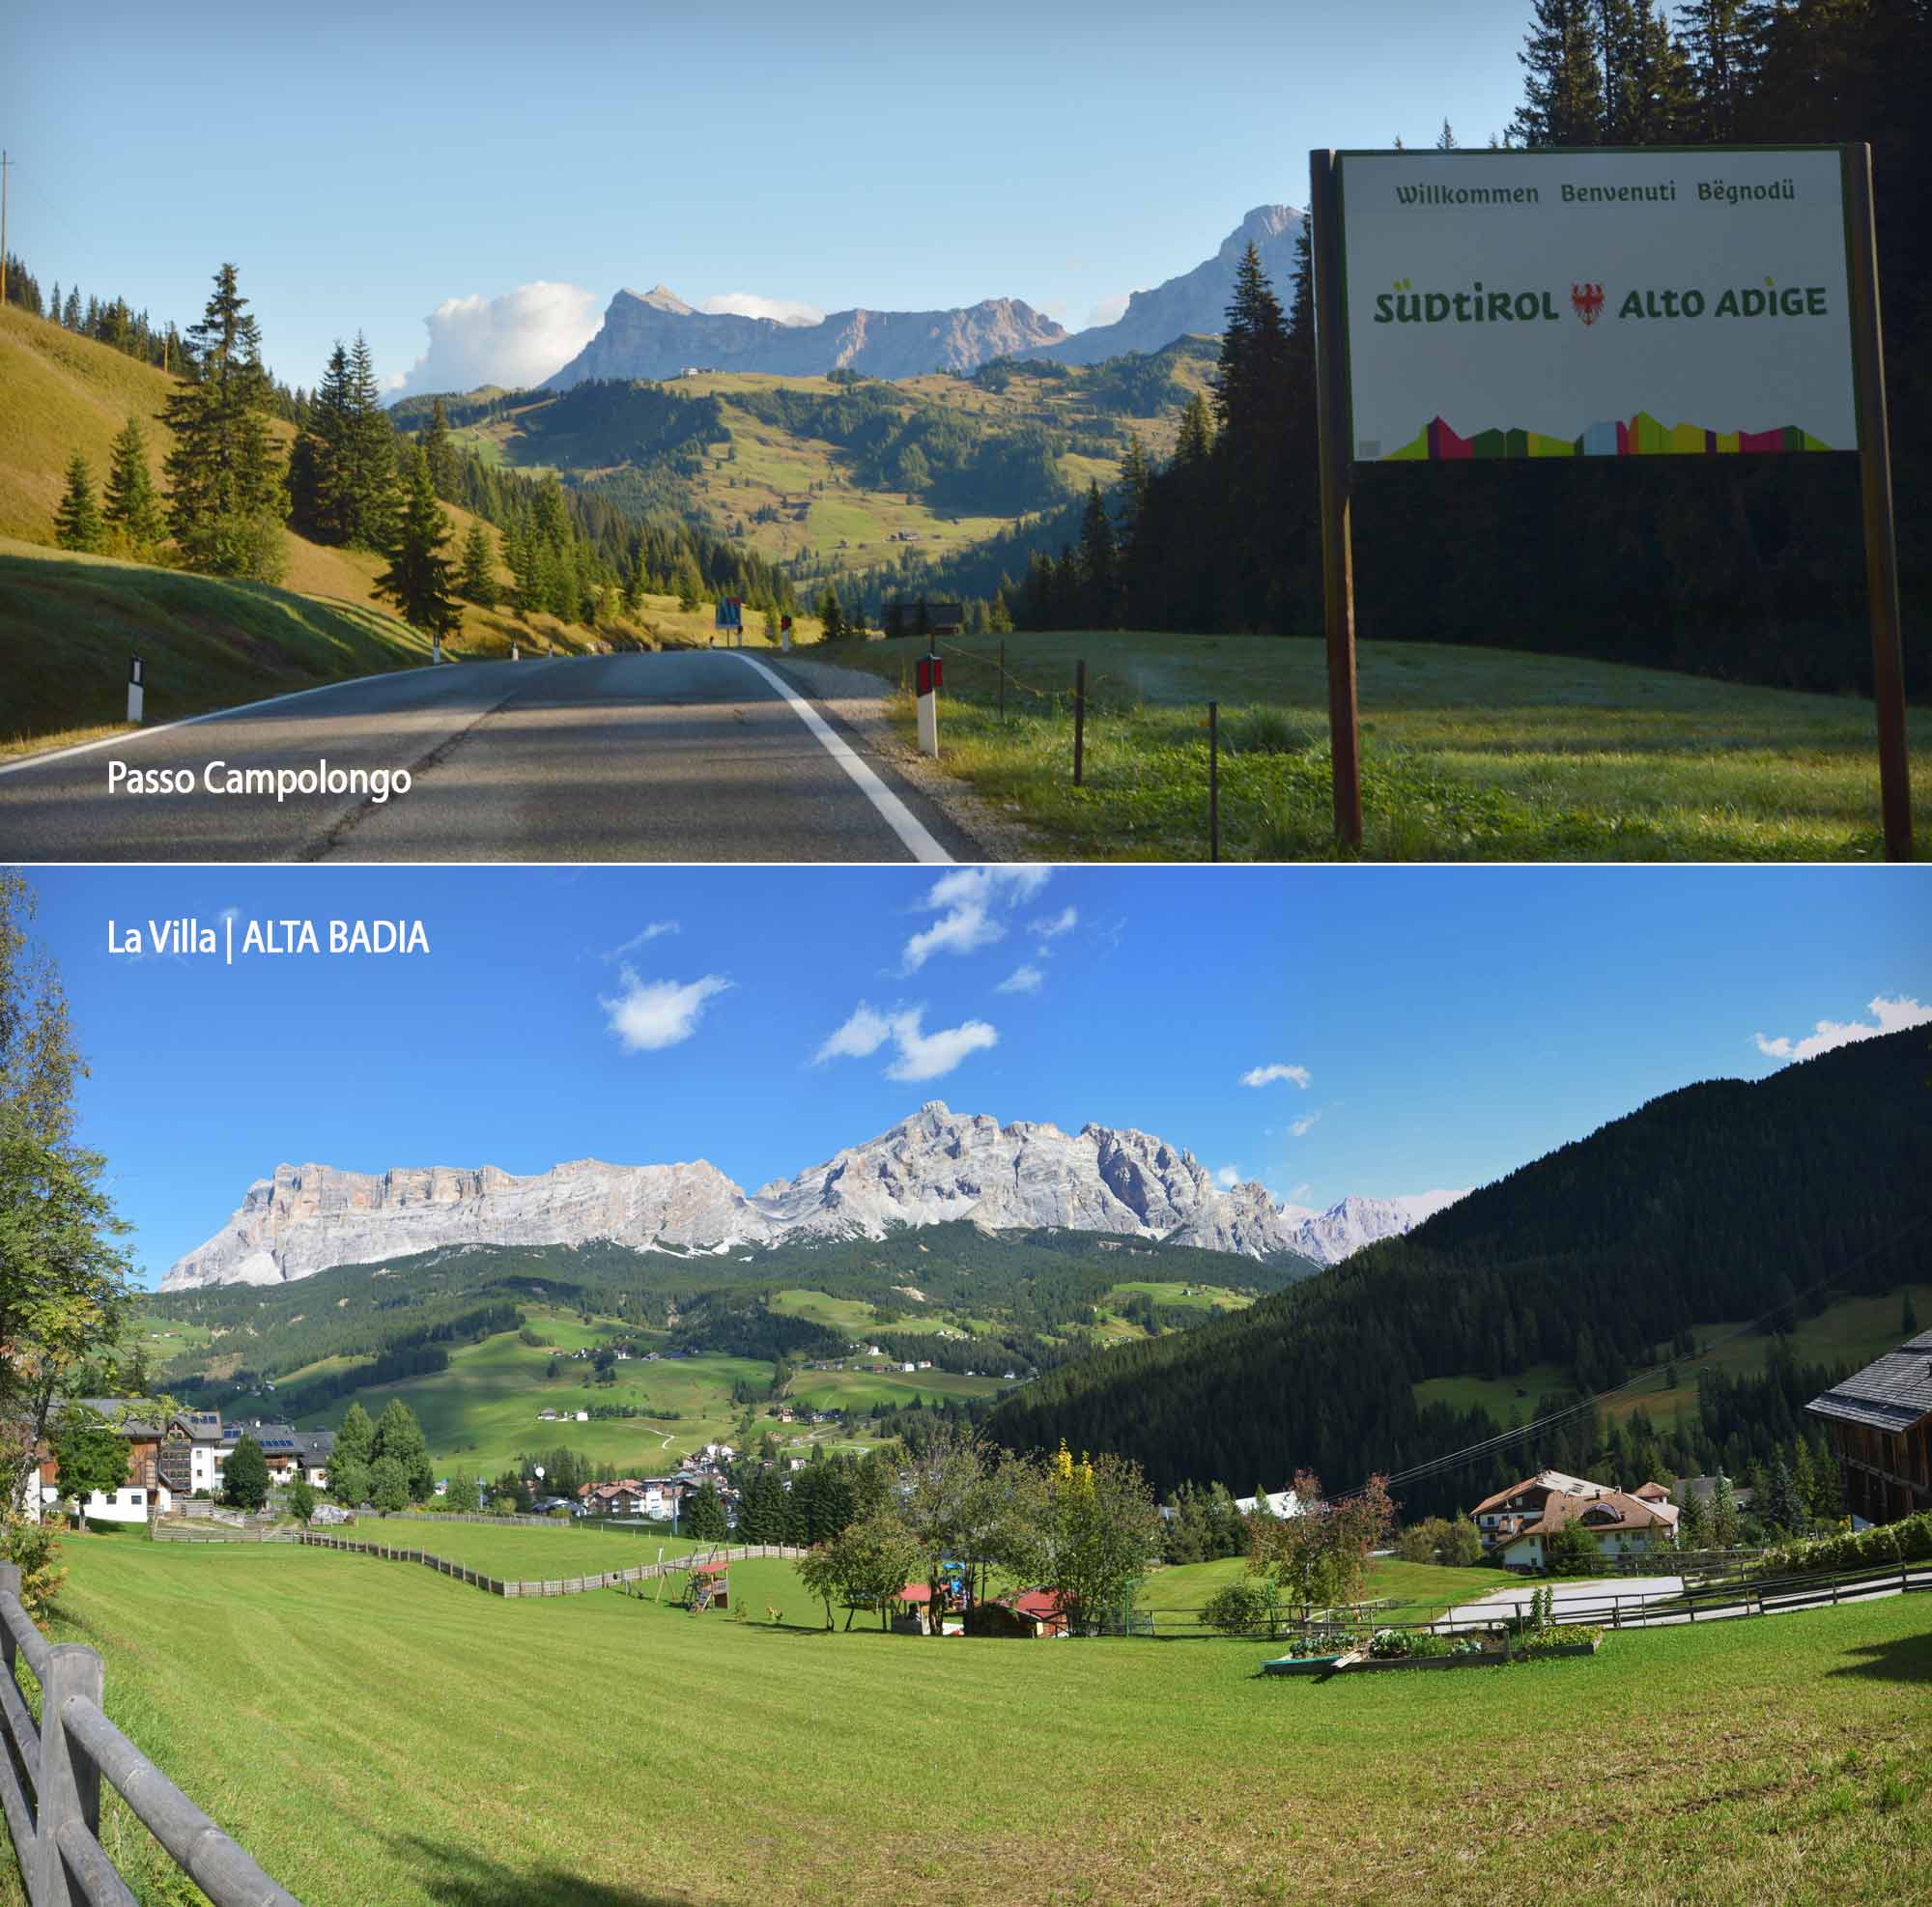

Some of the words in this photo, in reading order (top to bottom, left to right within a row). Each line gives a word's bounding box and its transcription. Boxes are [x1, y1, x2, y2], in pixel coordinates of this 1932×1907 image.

[1396, 184, 1539, 204] Willkommen
[1561, 180, 1676, 202] Benvenuti
[1698, 179, 1795, 205] Bëgnodü
